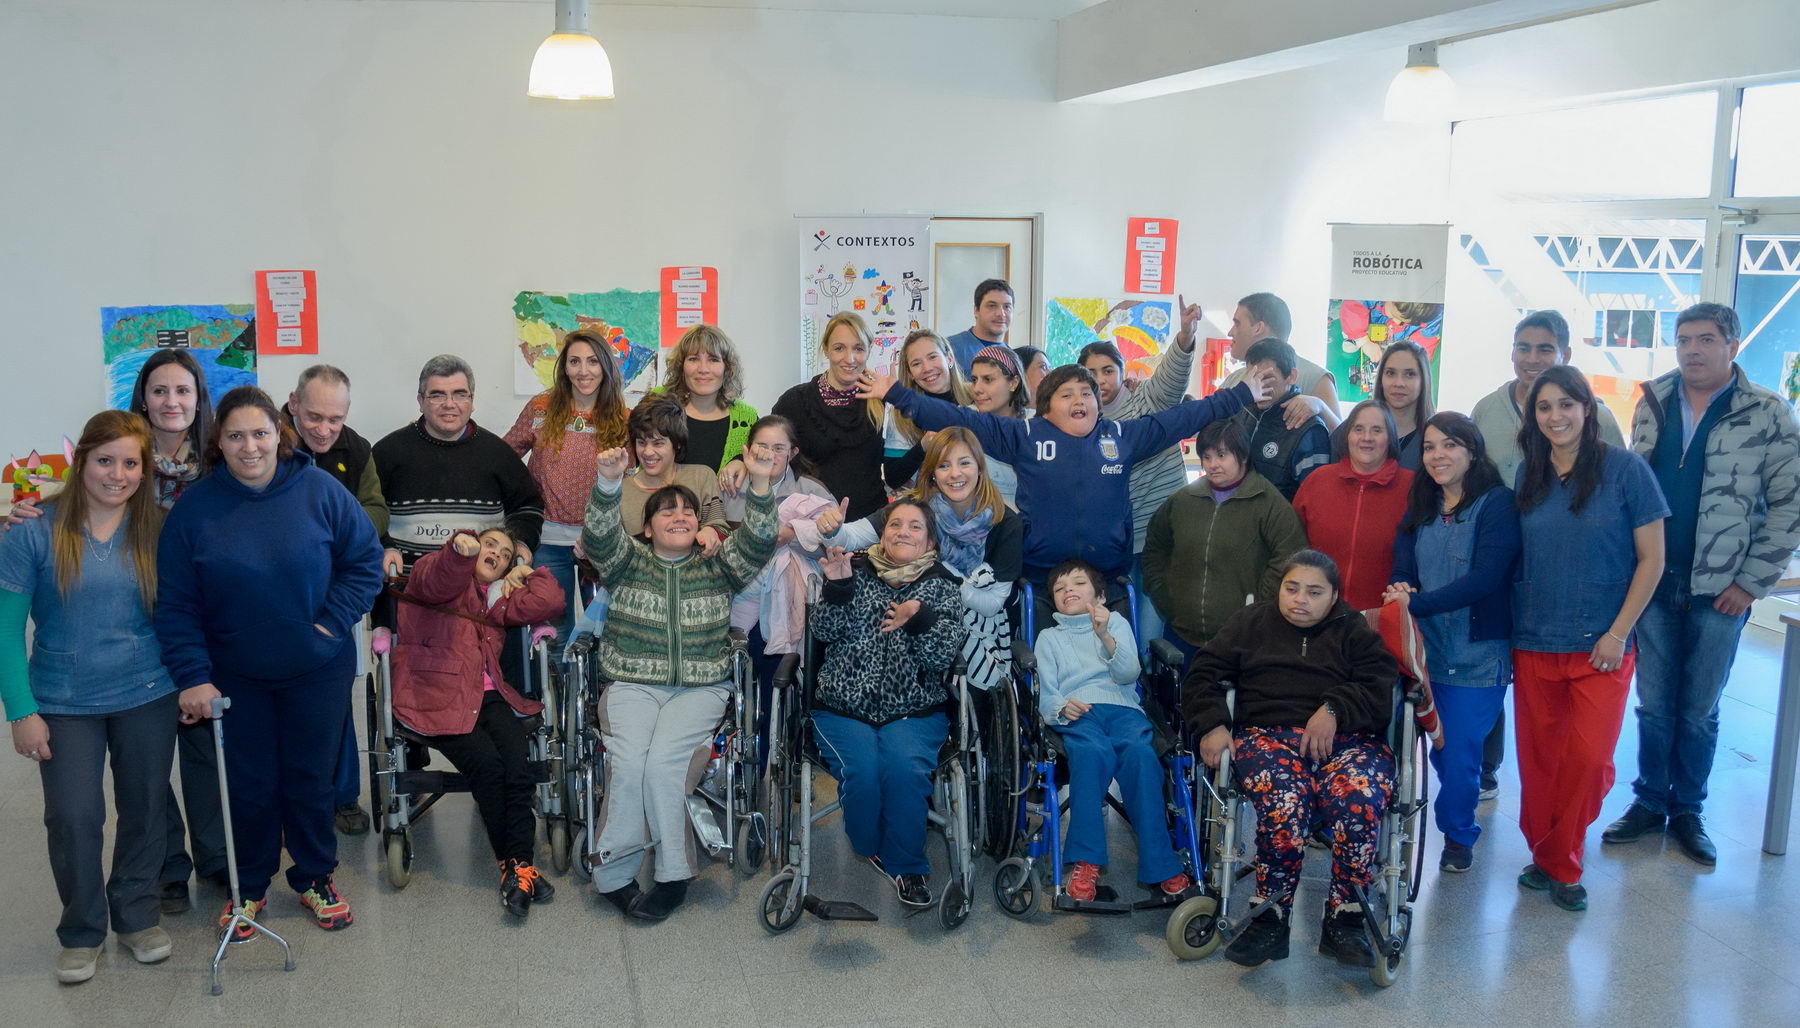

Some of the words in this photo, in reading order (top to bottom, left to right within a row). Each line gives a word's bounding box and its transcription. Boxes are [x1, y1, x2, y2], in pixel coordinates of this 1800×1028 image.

[836, 236, 915, 247] CONTEXTOS
[1352, 254, 1423, 269] ROBÓTICA
[1035, 440, 1056, 461] 10
